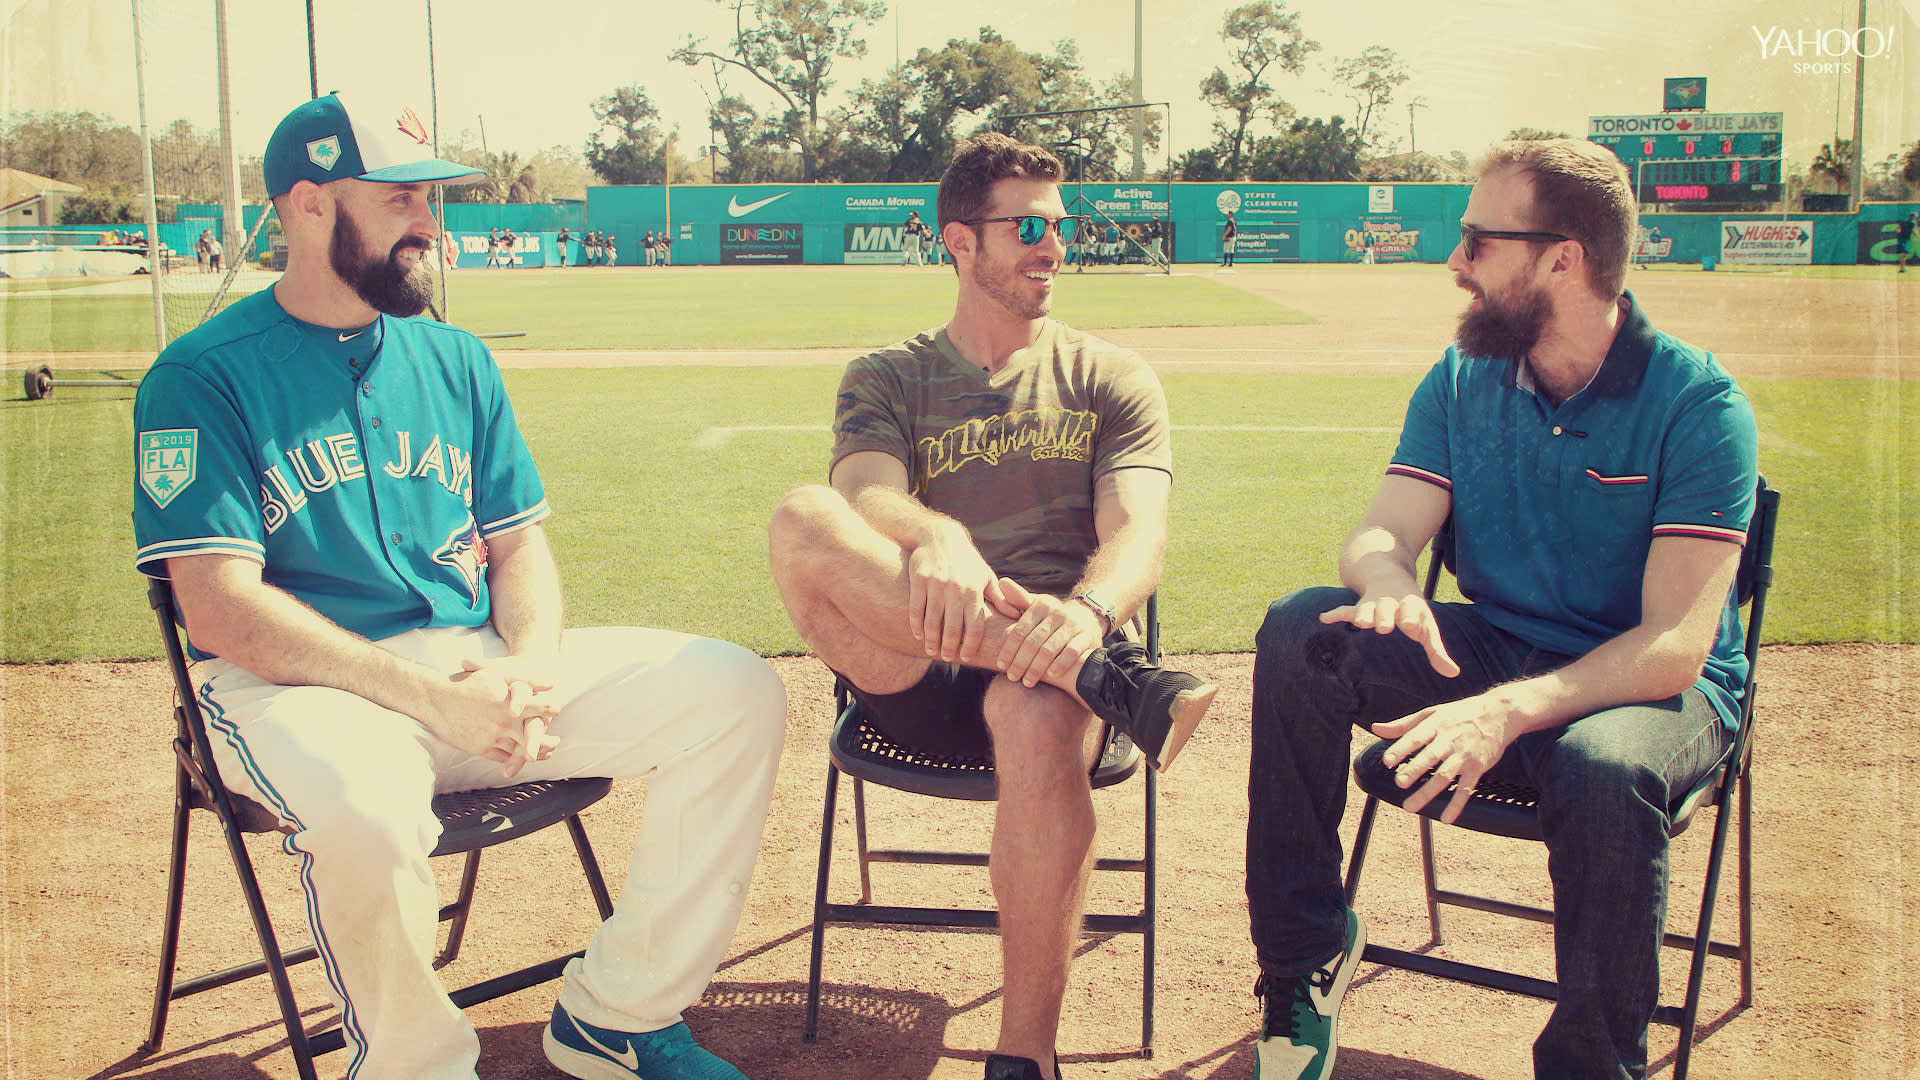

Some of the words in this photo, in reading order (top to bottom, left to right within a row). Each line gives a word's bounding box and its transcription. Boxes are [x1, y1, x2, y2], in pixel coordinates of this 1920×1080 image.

[1593, 118, 1675, 132] TORONTO
[1694, 116, 1736, 131] BLUE
[1737, 115, 1778, 131] JAYS
[1113, 188, 1153, 199] Active
[1095, 200, 1131, 210] Green
[727, 228, 796, 242] DUNEDIN
[850, 226, 904, 251] MN
[1743, 226, 1800, 241] HUGHES
[163, 434, 192, 446] 2019
[146, 449, 187, 470] FLA
[260, 431, 367, 536] BLUE
